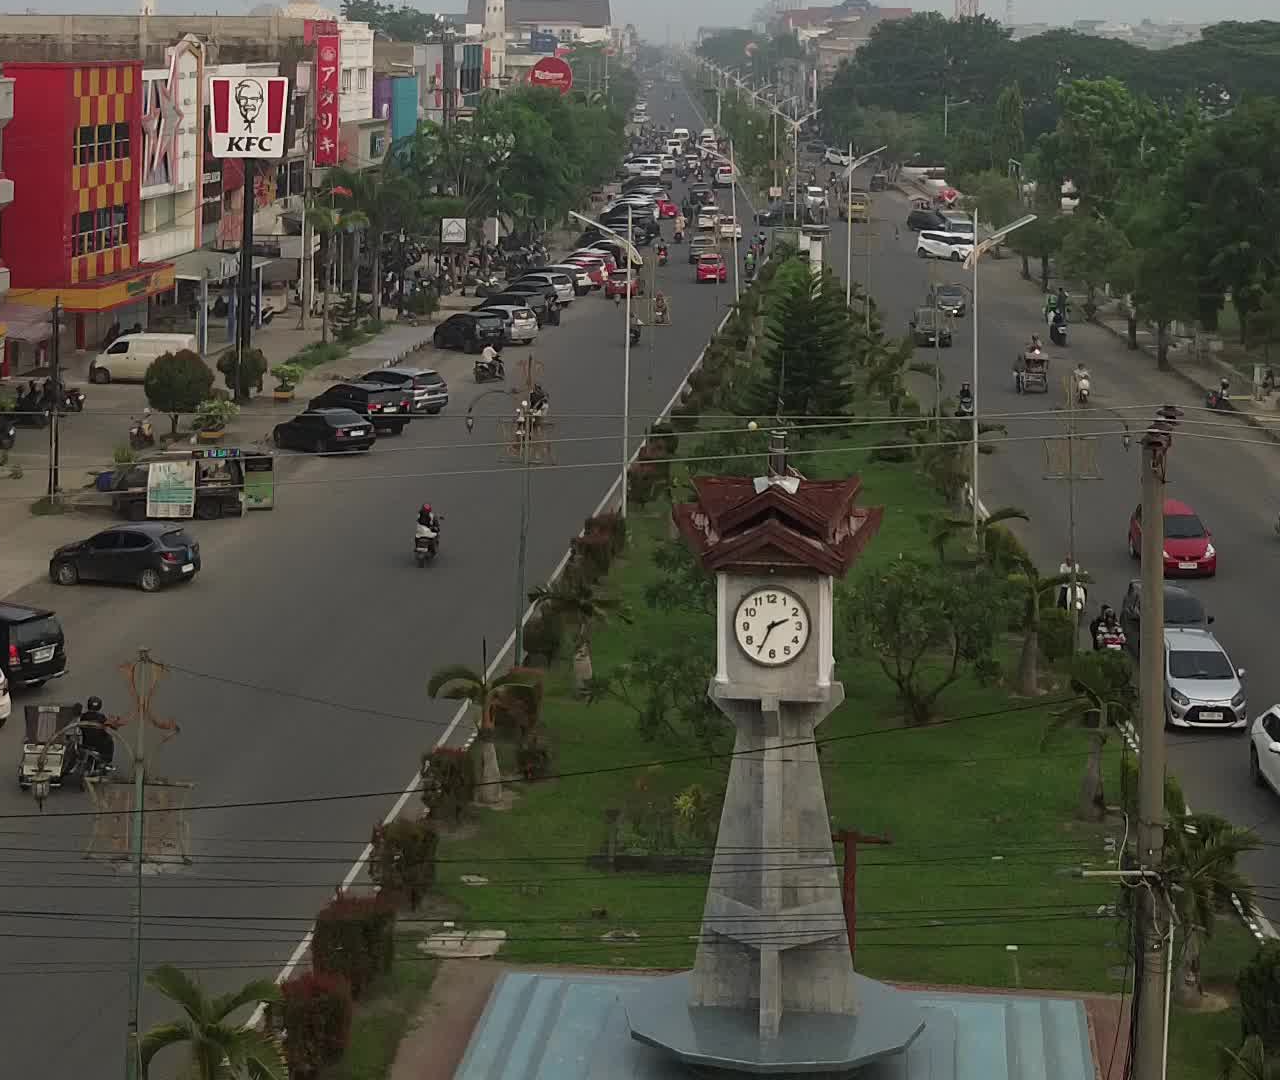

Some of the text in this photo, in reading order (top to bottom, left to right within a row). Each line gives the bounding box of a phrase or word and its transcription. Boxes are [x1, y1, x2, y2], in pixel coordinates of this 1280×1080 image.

[227, 137, 272, 151] KFC
[753, 596, 762, 606] 11
[766, 594, 777, 603] 12
[782, 597, 787, 606] 1
[744, 607, 757, 617] 10
[791, 607, 799, 617] 2
[742, 621, 750, 631] 9
[795, 621, 802, 631] 3
[745, 635, 753, 645] 8
[791, 635, 799, 644] 4
[768, 649, 776, 659] 6
[783, 645, 791, 655] 5
